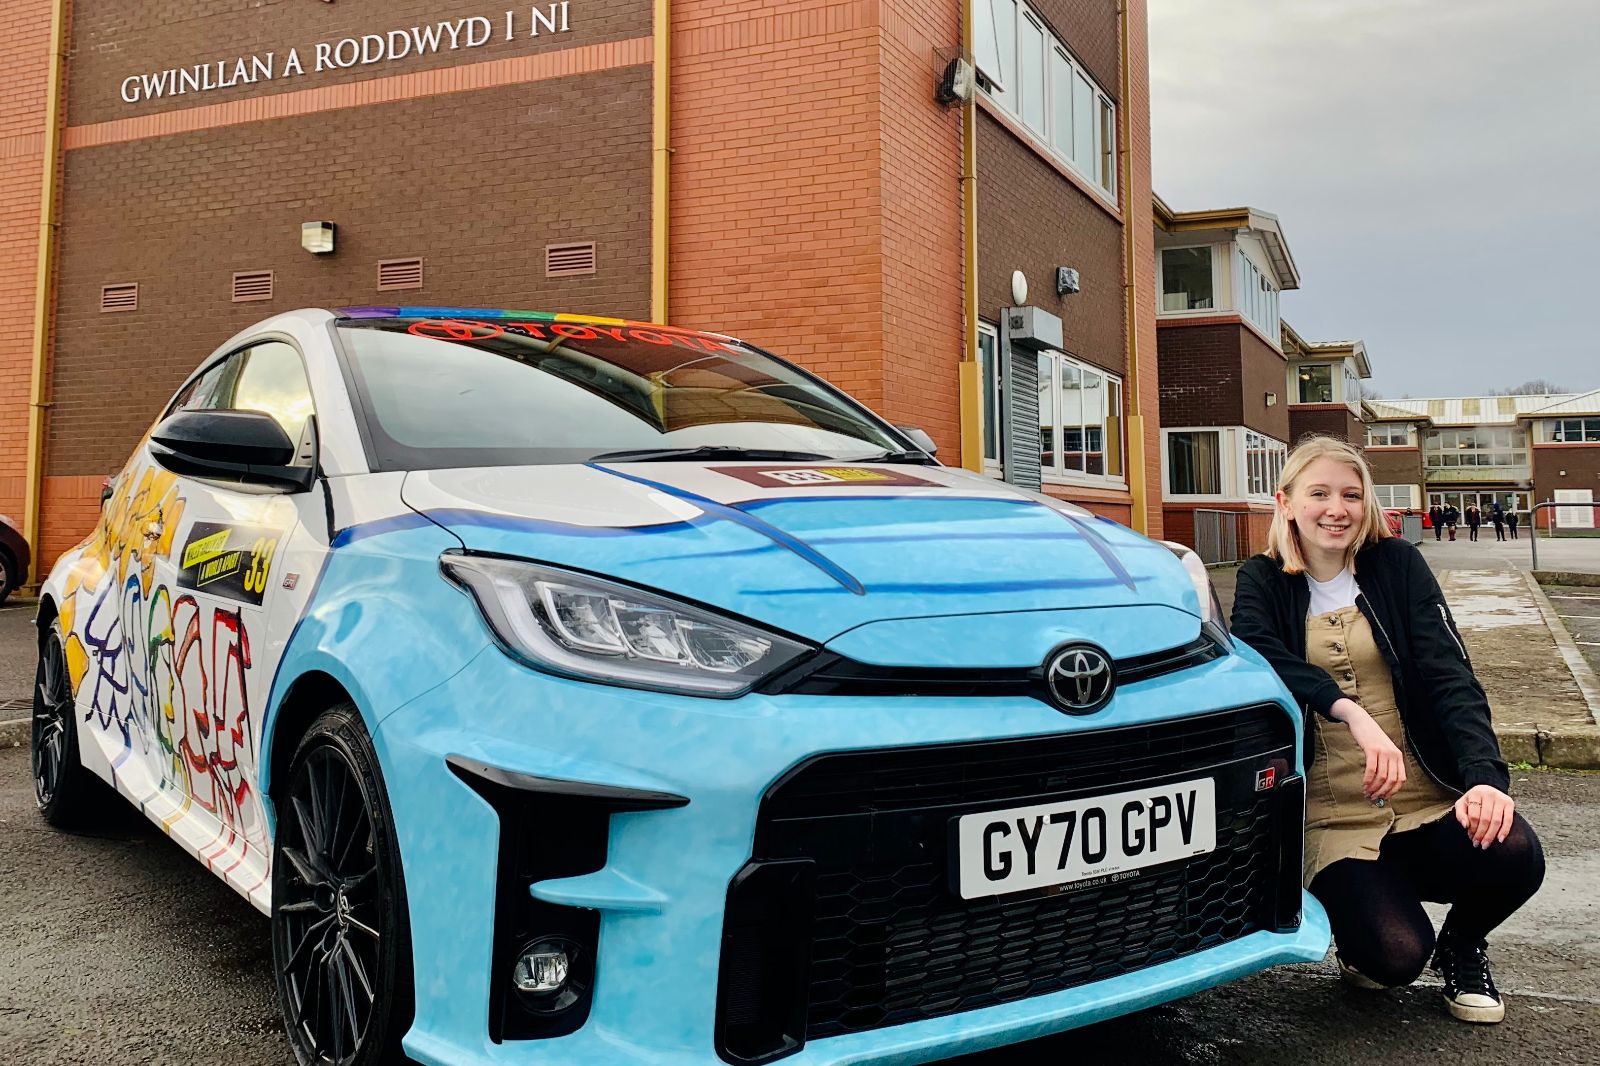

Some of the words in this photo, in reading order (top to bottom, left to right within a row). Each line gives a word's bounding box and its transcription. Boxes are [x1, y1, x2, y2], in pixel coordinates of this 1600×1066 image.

[120, 52, 275, 103] GWINLLAN
[282, 47, 304, 76] A
[314, 16, 492, 72] RODDWYD
[505, 11, 514, 41] I
[529, 1, 571, 36] NI
[508, 322, 741, 355] TOYOTA
[244, 536, 277, 593] 33
[1259, 776, 1273, 789] GR
[983, 806, 1107, 882] GY70
[1121, 790, 1197, 857] GPV
[1059, 876, 1107, 892] www.toyota.co.uk
[1119, 870, 1140, 881] TOYOTA
